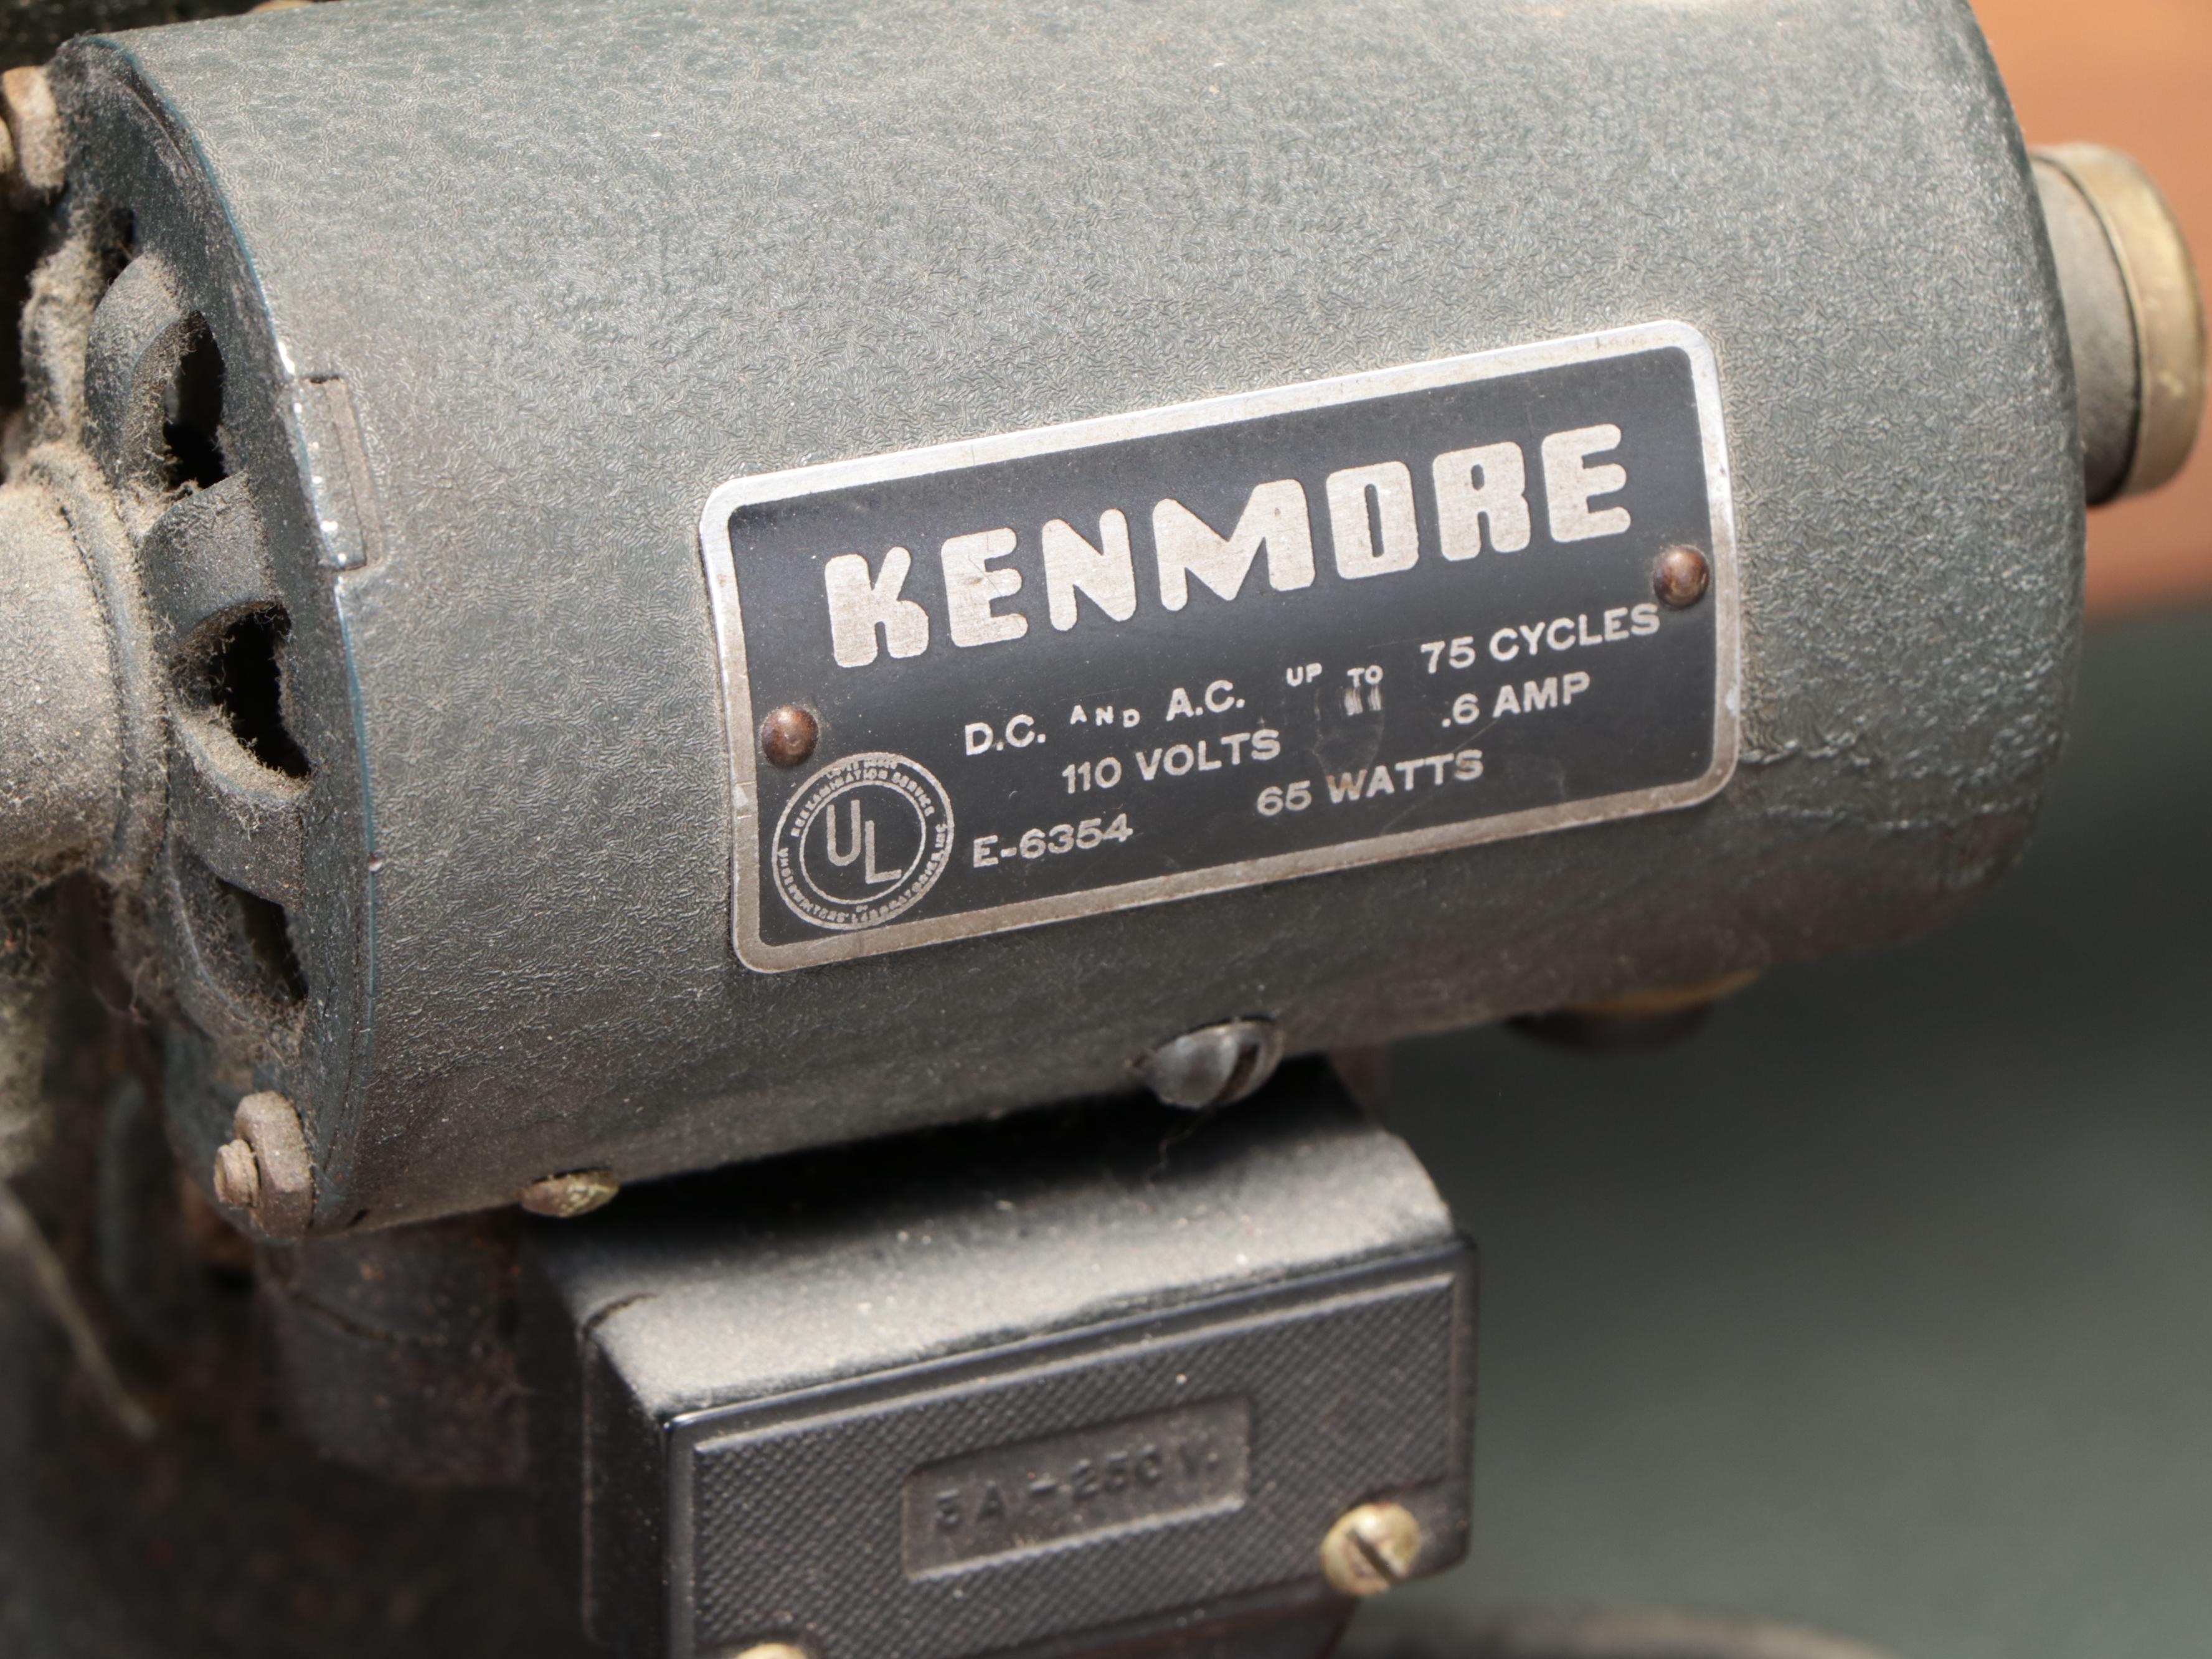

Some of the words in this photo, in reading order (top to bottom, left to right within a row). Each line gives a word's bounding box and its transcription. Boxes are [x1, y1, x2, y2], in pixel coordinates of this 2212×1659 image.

[824, 423, 1631, 668] KENMORE
[965, 714, 1046, 756] D.C.
[1070, 704, 1140, 728] AND
[1166, 679, 1245, 722] A.C.
[1286, 663, 1323, 687] UP
[1346, 664, 1383, 685] TO
[1420, 636, 1476, 674] 75
[1489, 603, 1660, 661] CYCLES
[1442, 693, 1480, 727] .6
[1492, 671, 1590, 718] AMP
[1062, 757, 1122, 794] 110
[1135, 728, 1281, 781] VOLTS
[1257, 781, 1312, 816] 65
[1326, 749, 1483, 804] WATTS
[826, 799, 902, 884] UL
[973, 813, 1133, 868] E-6354
